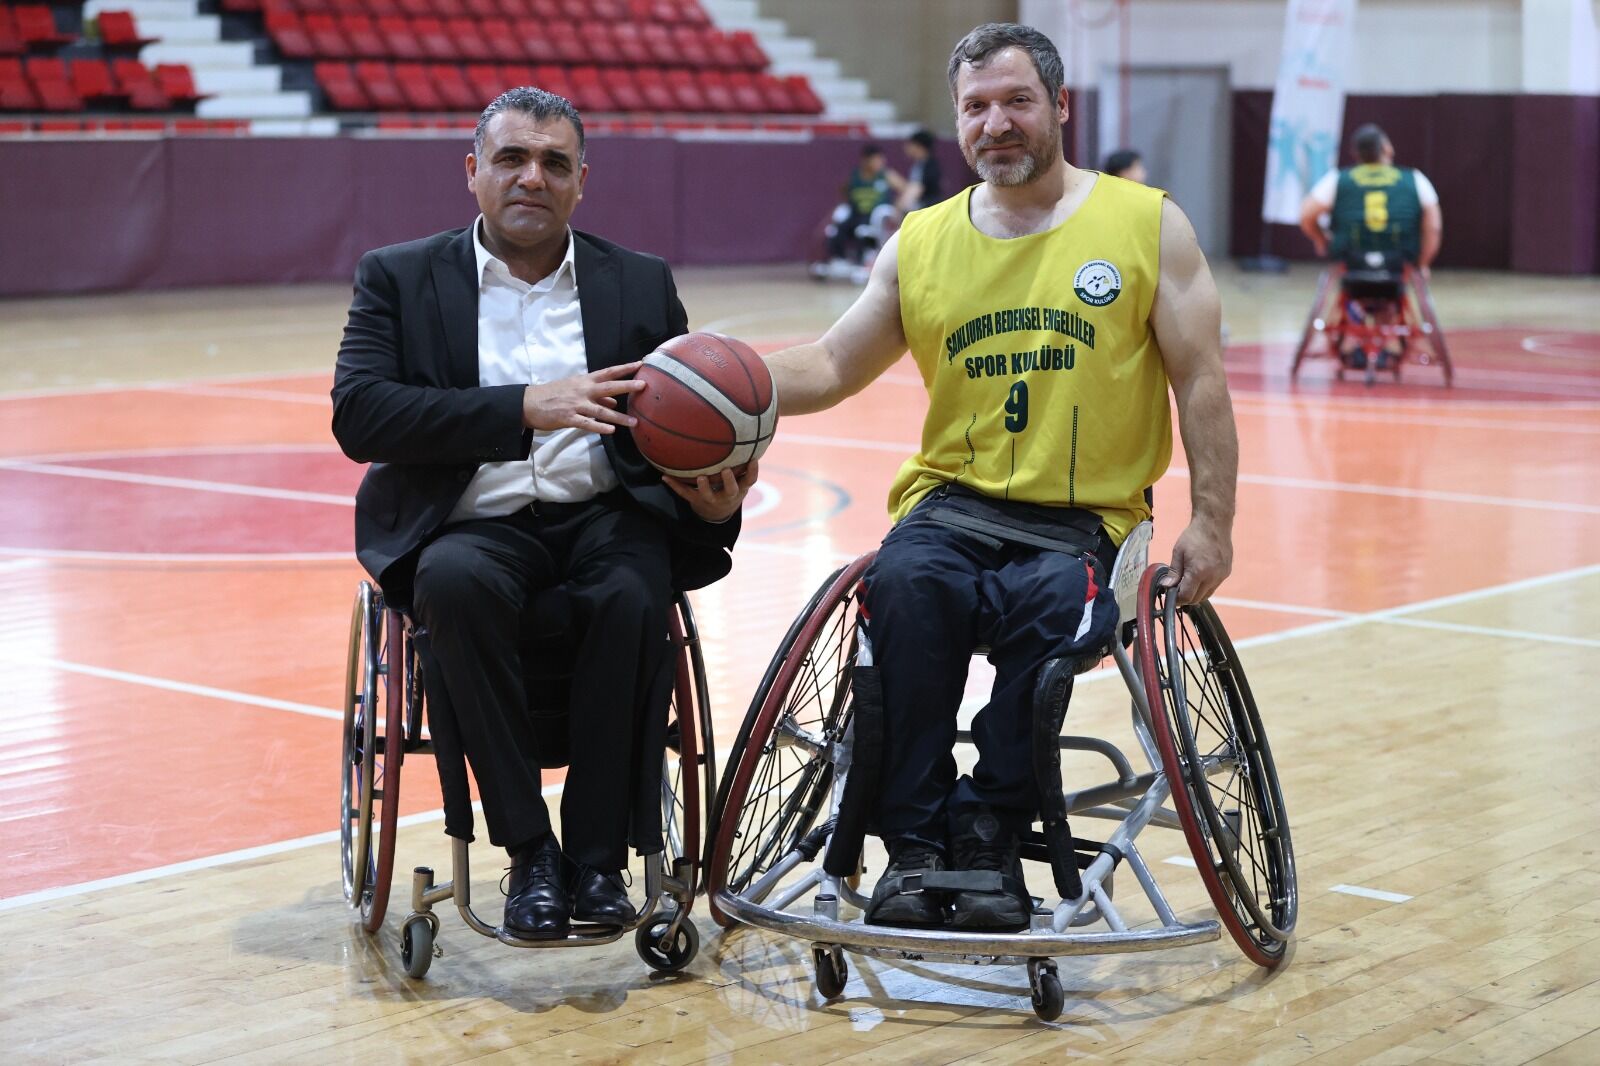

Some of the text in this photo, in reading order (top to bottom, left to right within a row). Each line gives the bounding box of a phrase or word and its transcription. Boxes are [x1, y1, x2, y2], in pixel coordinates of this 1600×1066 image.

[1080, 292, 1094, 303] SPOR
[946, 307, 1095, 365] ŞANLIURFA BEDENSEL ENGELLİLER
[965, 344, 1075, 379] SPOR KULÜBÜ
[1004, 380, 1029, 433] 9
